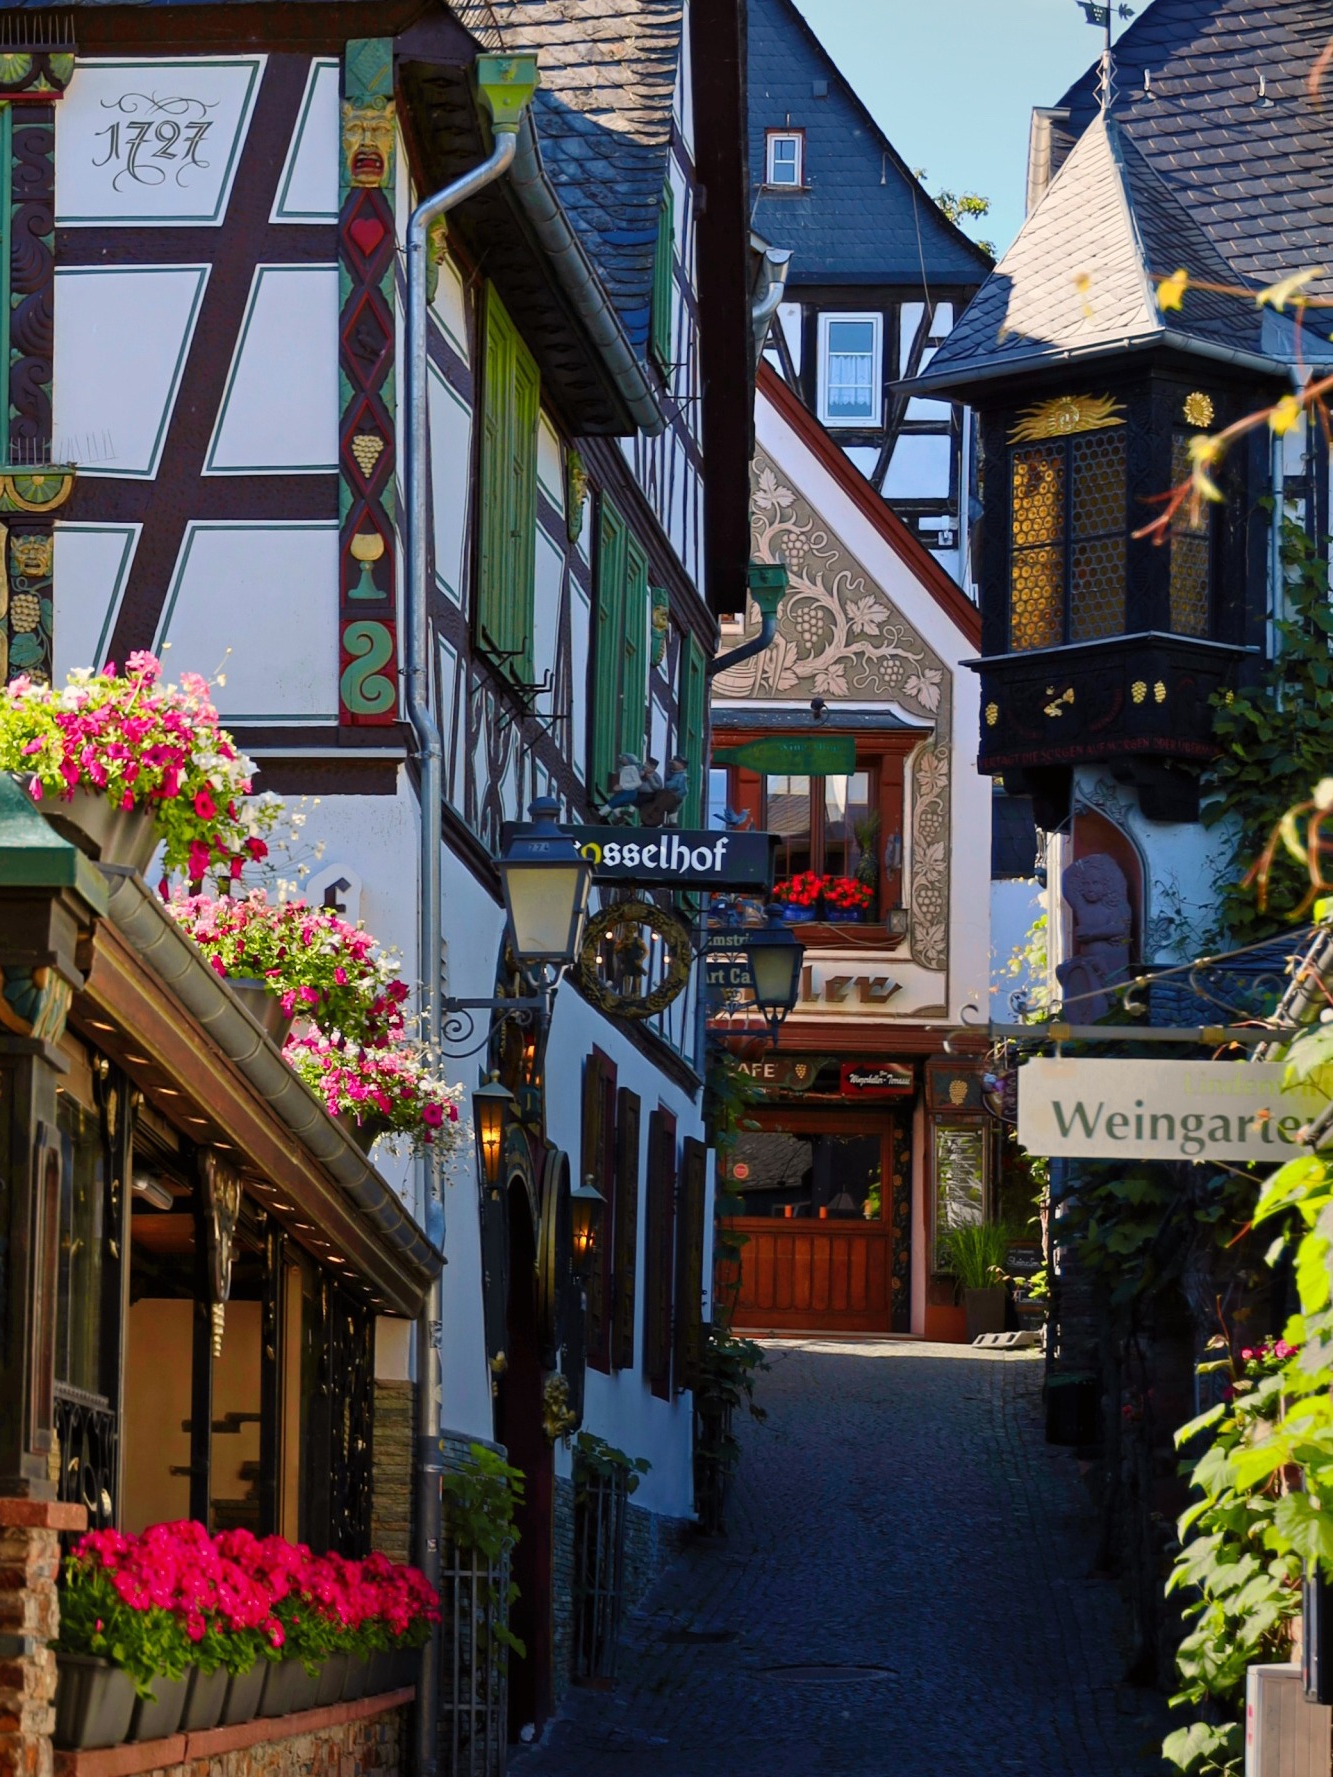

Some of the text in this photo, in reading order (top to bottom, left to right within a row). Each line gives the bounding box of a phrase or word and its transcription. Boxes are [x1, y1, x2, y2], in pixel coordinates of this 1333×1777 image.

[91, 119, 215, 192] 1727
[574, 834, 730, 874] osselhof
[1052, 1099, 1317, 1155] Weingarte
